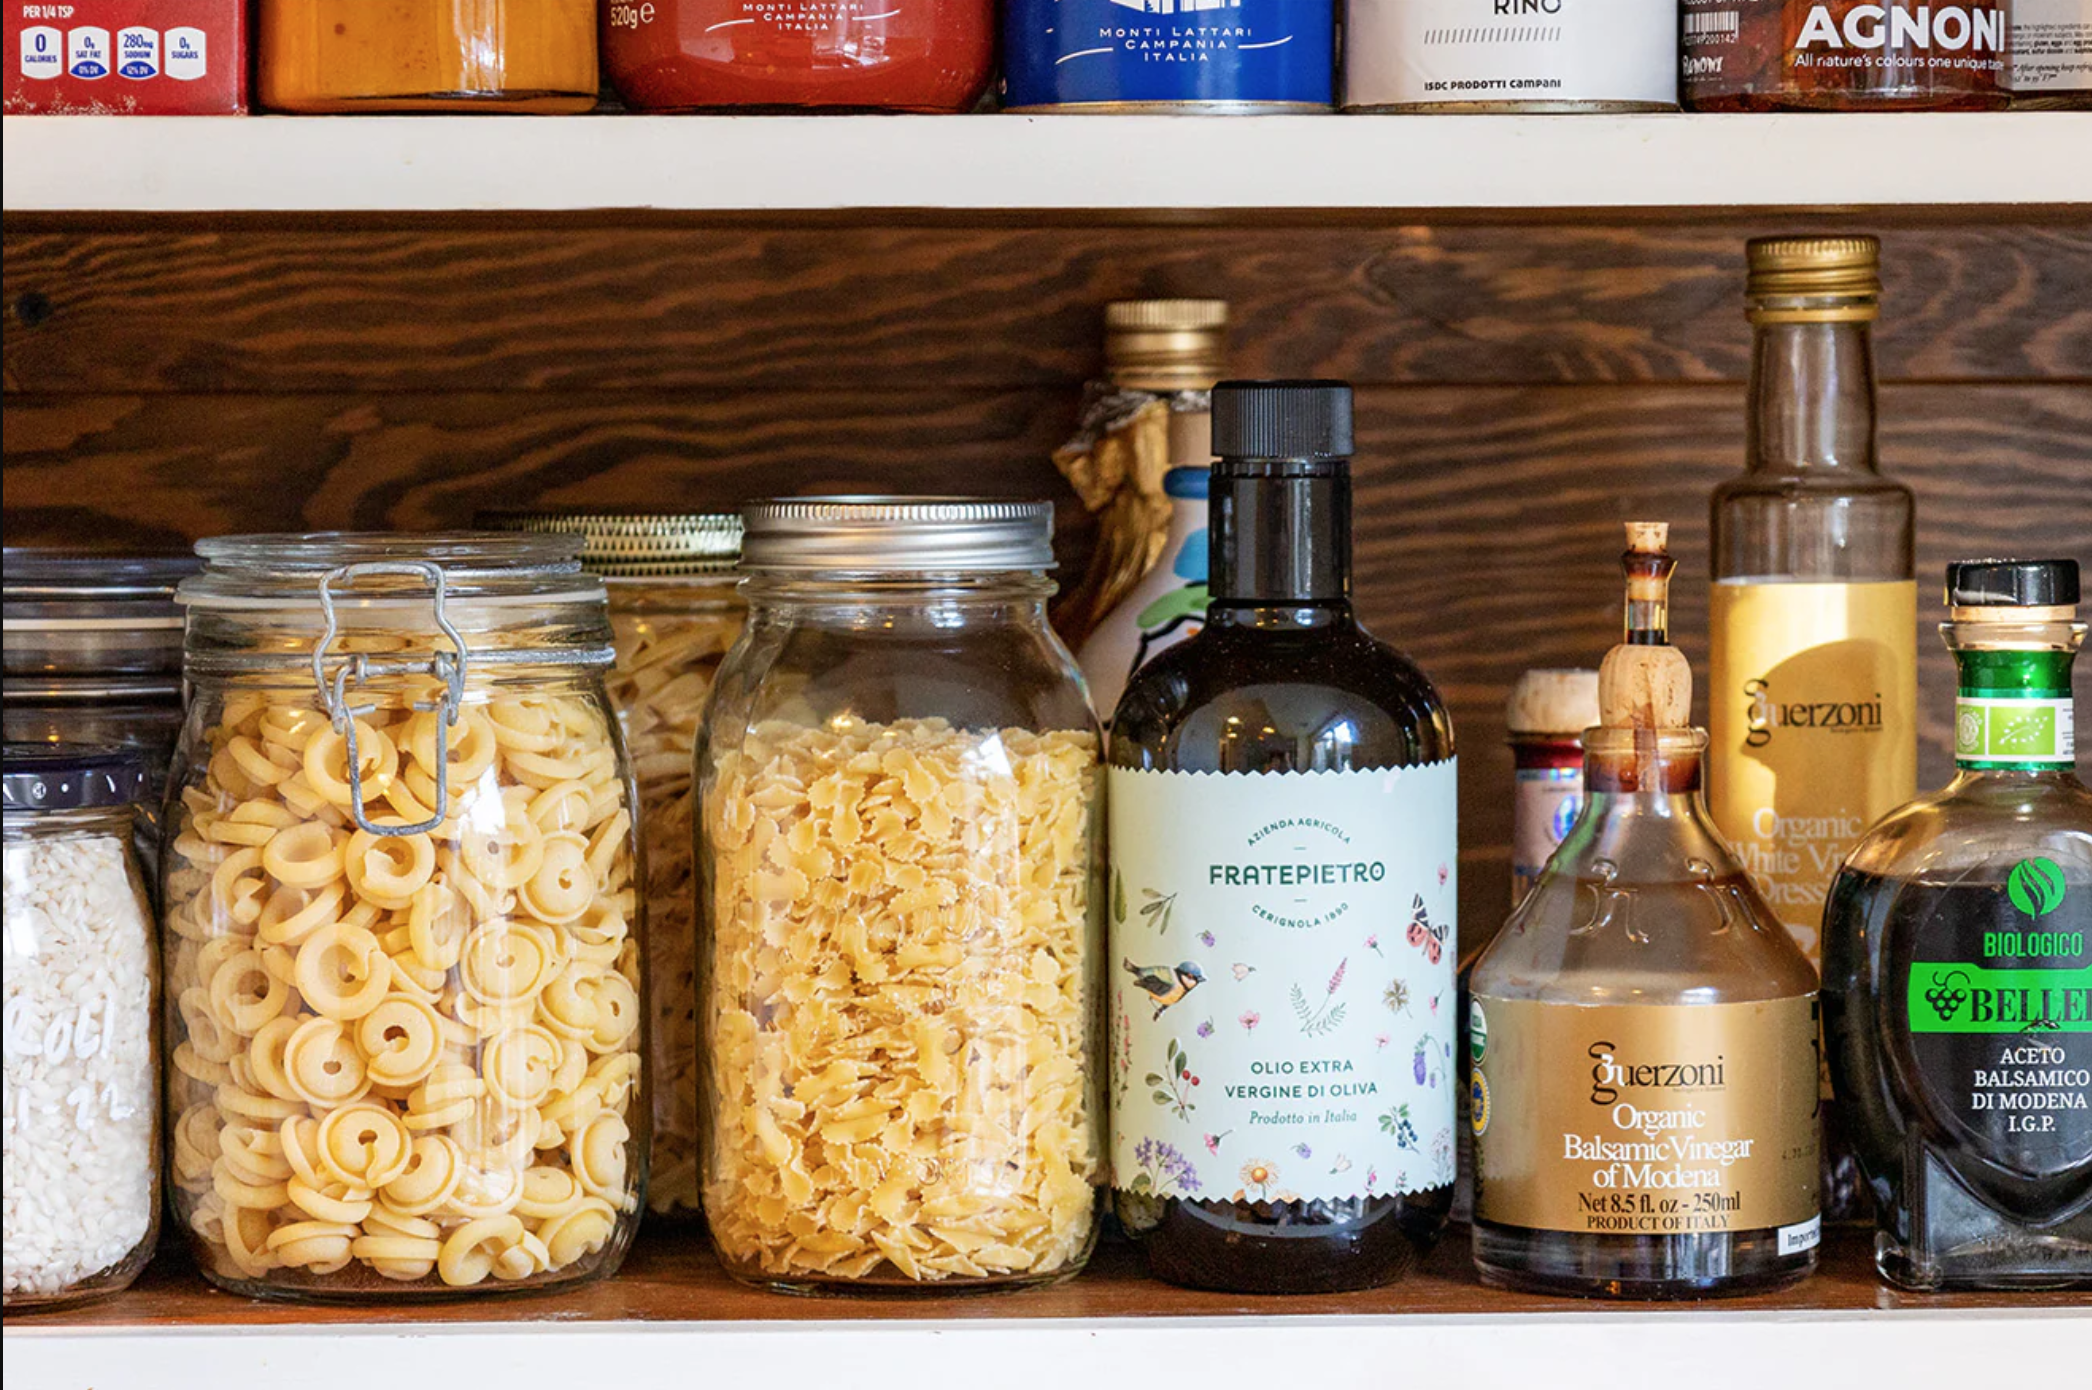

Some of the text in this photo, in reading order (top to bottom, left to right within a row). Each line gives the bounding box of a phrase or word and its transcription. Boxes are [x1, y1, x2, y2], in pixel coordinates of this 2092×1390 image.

[23, 4, 75, 19] PER 1/4 TSP
[742, 3, 864, 12] MONTI LATTARI
[610, 5, 638, 29] 520g
[762, 13, 844, 21] CAMPANIA
[777, 22, 830, 31] ITALIA
[1099, 26, 1252, 38] MONTI LATTARI
[1794, 4, 2005, 52] AGNONI
[35, 33, 47, 53] 0
[1124, 39, 1228, 50] CAMPANIA
[24, 54, 57, 63] CALORIES
[124, 50, 152, 59] SODIUM
[171, 50, 199, 59] SUGARS
[1143, 51, 1209, 62] ITALIA
[1795, 53, 1813, 68] All
[1875, 54, 1925, 68] colours
[1928, 56, 1951, 69] one
[1954, 56, 1987, 71] unique
[1424, 80, 1448, 91] ISDC
[1450, 79, 1506, 90] PRODOTTI
[1247, 817, 1351, 847] AZIENDA AGRICOLA
[1753, 806, 1862, 847] Organic
[1208, 861, 1386, 886] FRATEPIETRO
[1251, 903, 1322, 929] CERIGNOLA
[1983, 931, 2084, 958] BIOLOGICO
[2000, 1047, 2066, 1066] ACETO
[1250, 1059, 1354, 1075] OLIO EXTRA
[1974, 1069, 2091, 1088] BALSAMICO
[1224, 1081, 1378, 1099] VERGINE DI OLIVA
[1972, 1092, 2089, 1110] DI MODENA
[1249, 1109, 1357, 1125] Prodotto in Italia
[1612, 1103, 1706, 1137] Organic
[2008, 1114, 2057, 1133] I.G.P.
[1563, 1133, 1670, 1162] Balsamic
[1667, 1135, 1755, 1167] Vinegar
[1592, 1163, 1722, 1189] of Modena
[1578, 1192, 1608, 1213] Net
[1610, 1192, 1636, 1214] 8.5
[1639, 1192, 1656, 1214] fl.
[1659, 1199, 1679, 1213] oz
[1693, 1190, 1742, 1212] 250ml
[1586, 1214, 1731, 1231] PRODUCT OF ITALY
